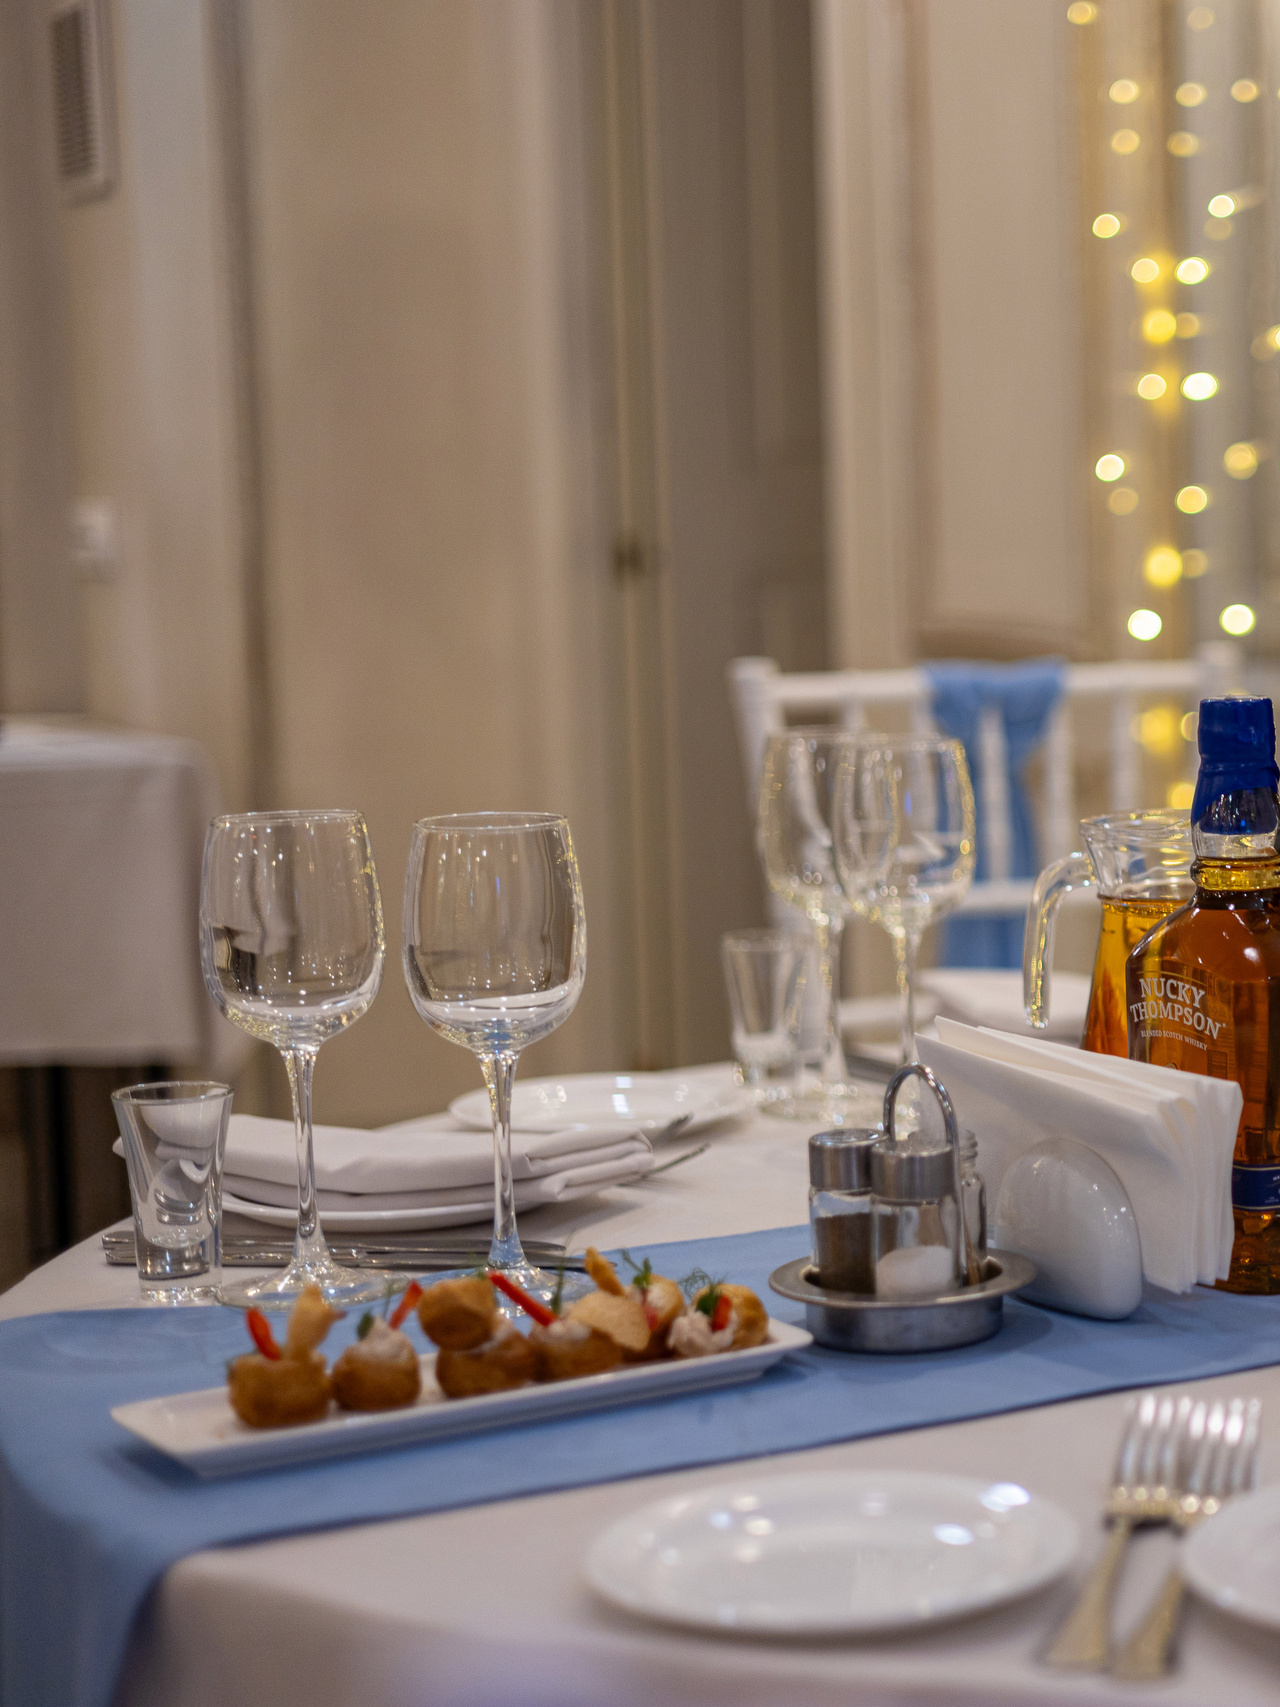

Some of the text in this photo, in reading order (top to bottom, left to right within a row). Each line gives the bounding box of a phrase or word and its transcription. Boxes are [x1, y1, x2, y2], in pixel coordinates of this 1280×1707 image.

[1139, 977, 1205, 1009] NUCKY
[1129, 1000, 1222, 1040] THOMPSON
[1141, 1029, 1208, 1052] BLENDED SCOTCH WHISKY
